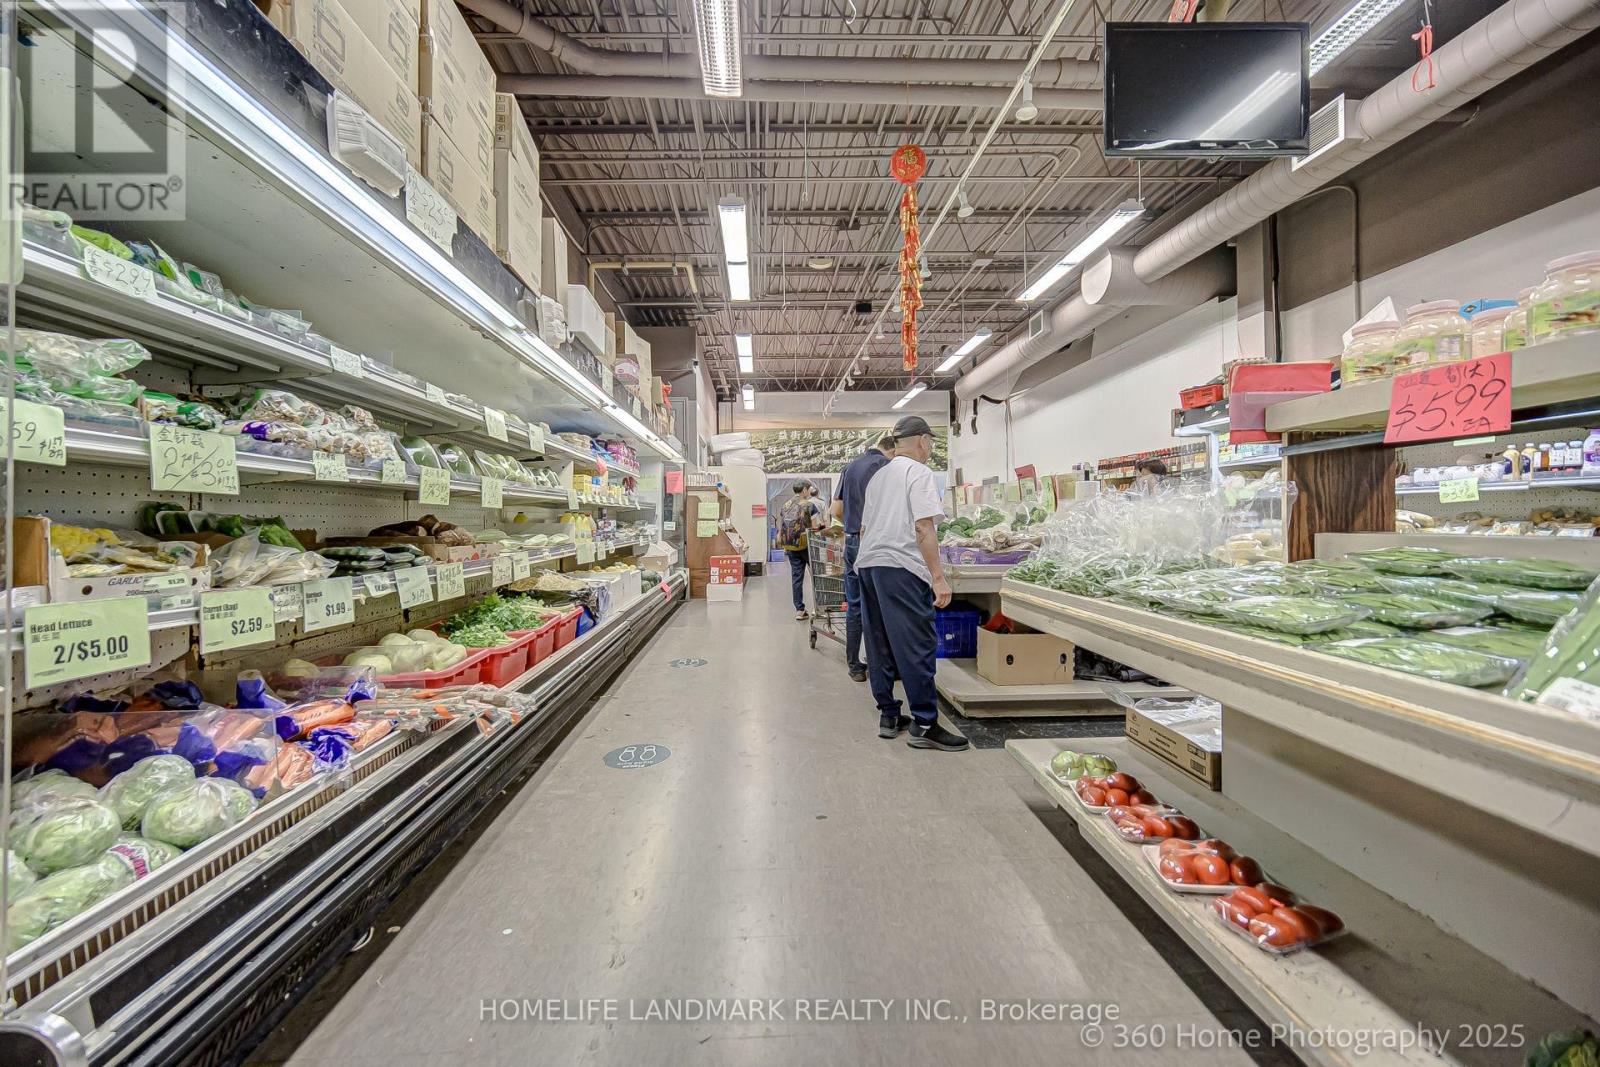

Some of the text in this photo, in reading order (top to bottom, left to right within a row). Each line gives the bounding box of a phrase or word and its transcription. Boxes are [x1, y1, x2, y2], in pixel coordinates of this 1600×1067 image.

[107, 576, 143, 586] GARLIC
[325, 601, 346, 616] $1.99
[30, 618, 94, 634] Head Lettuce
[231, 616, 263, 636] $2.59
[53, 634, 129, 666] 2/$5.00
